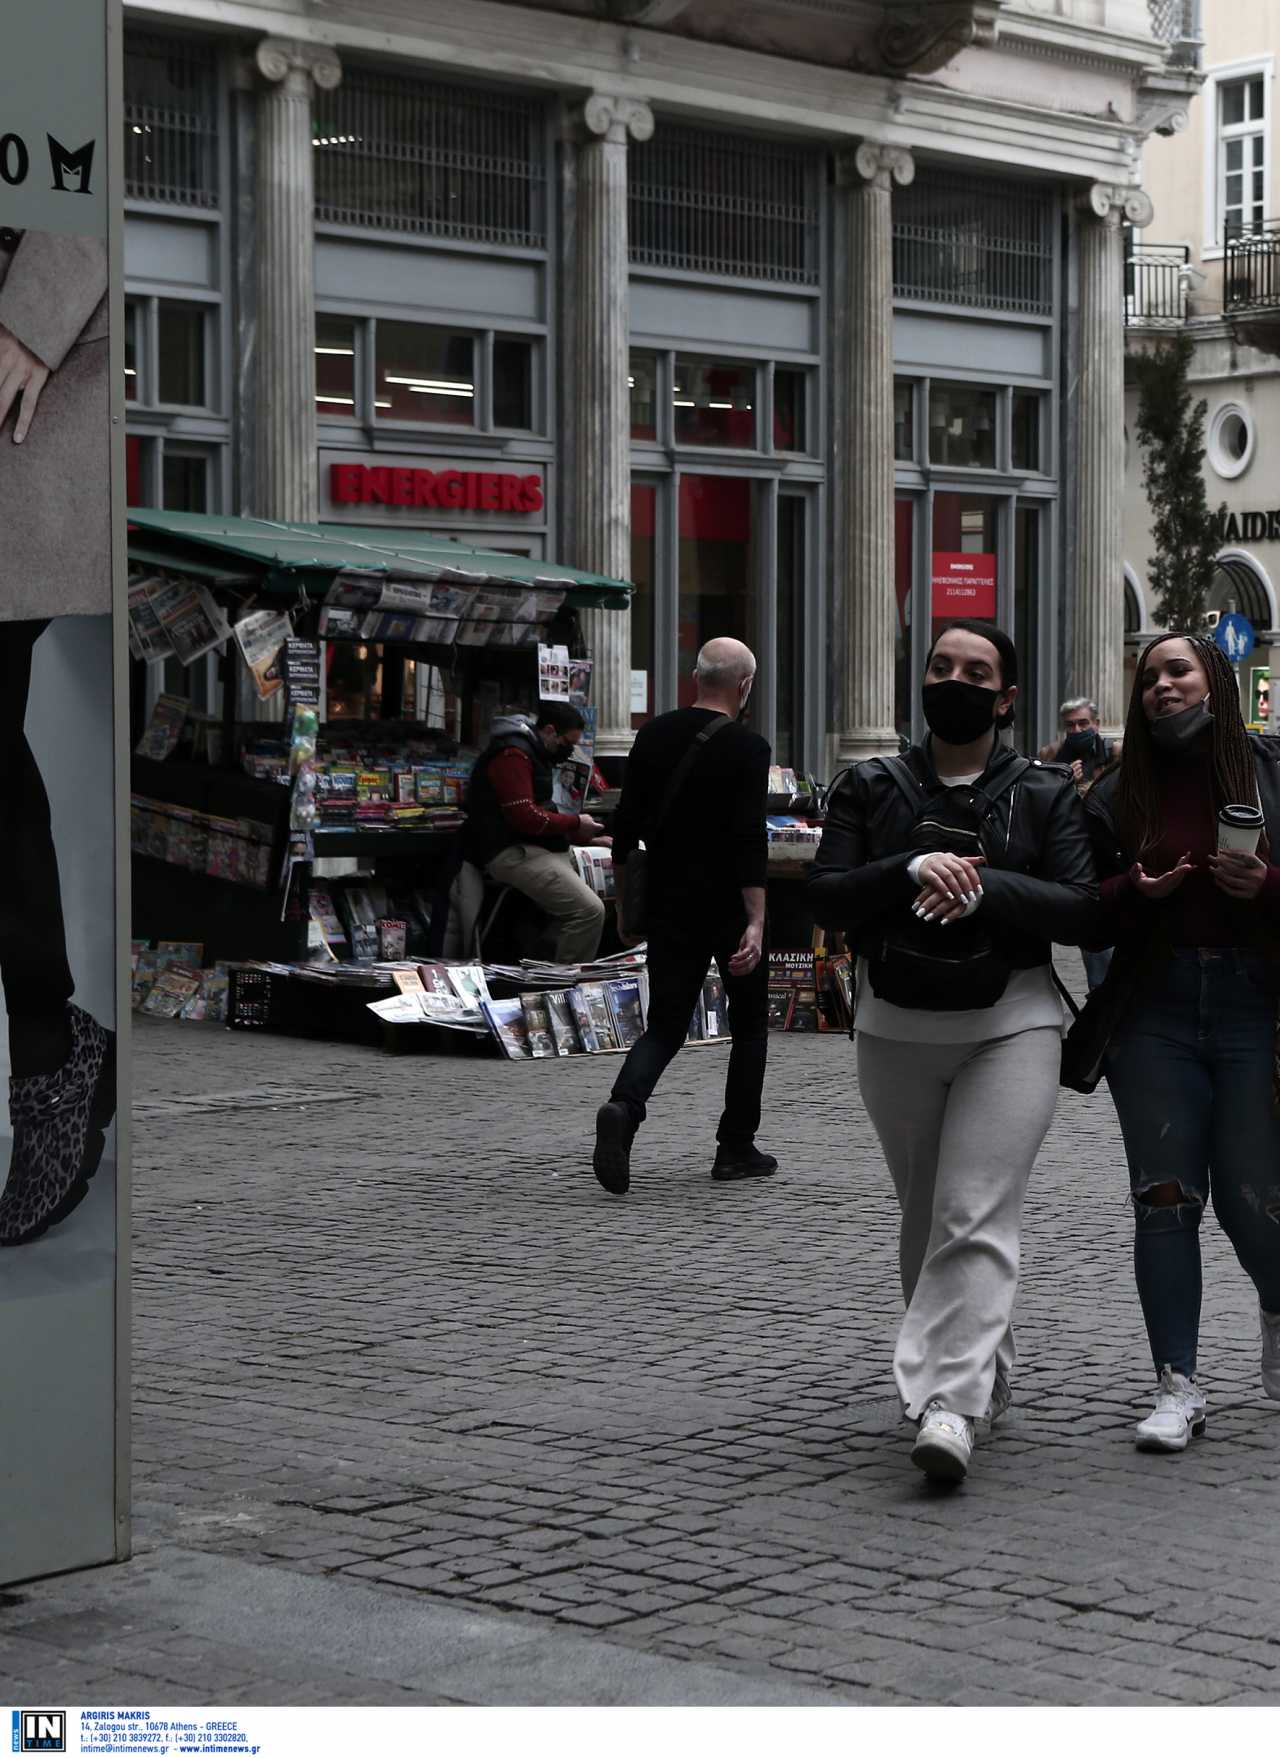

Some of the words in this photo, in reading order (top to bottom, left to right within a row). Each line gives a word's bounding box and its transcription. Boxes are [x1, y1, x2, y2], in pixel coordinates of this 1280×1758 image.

[330, 464, 544, 513] ENERGIERS
[768, 952, 814, 963] ΚΛΑΣΙΚΗ
[785, 962, 814, 970] ΜΟΥΣΙΚΗ
